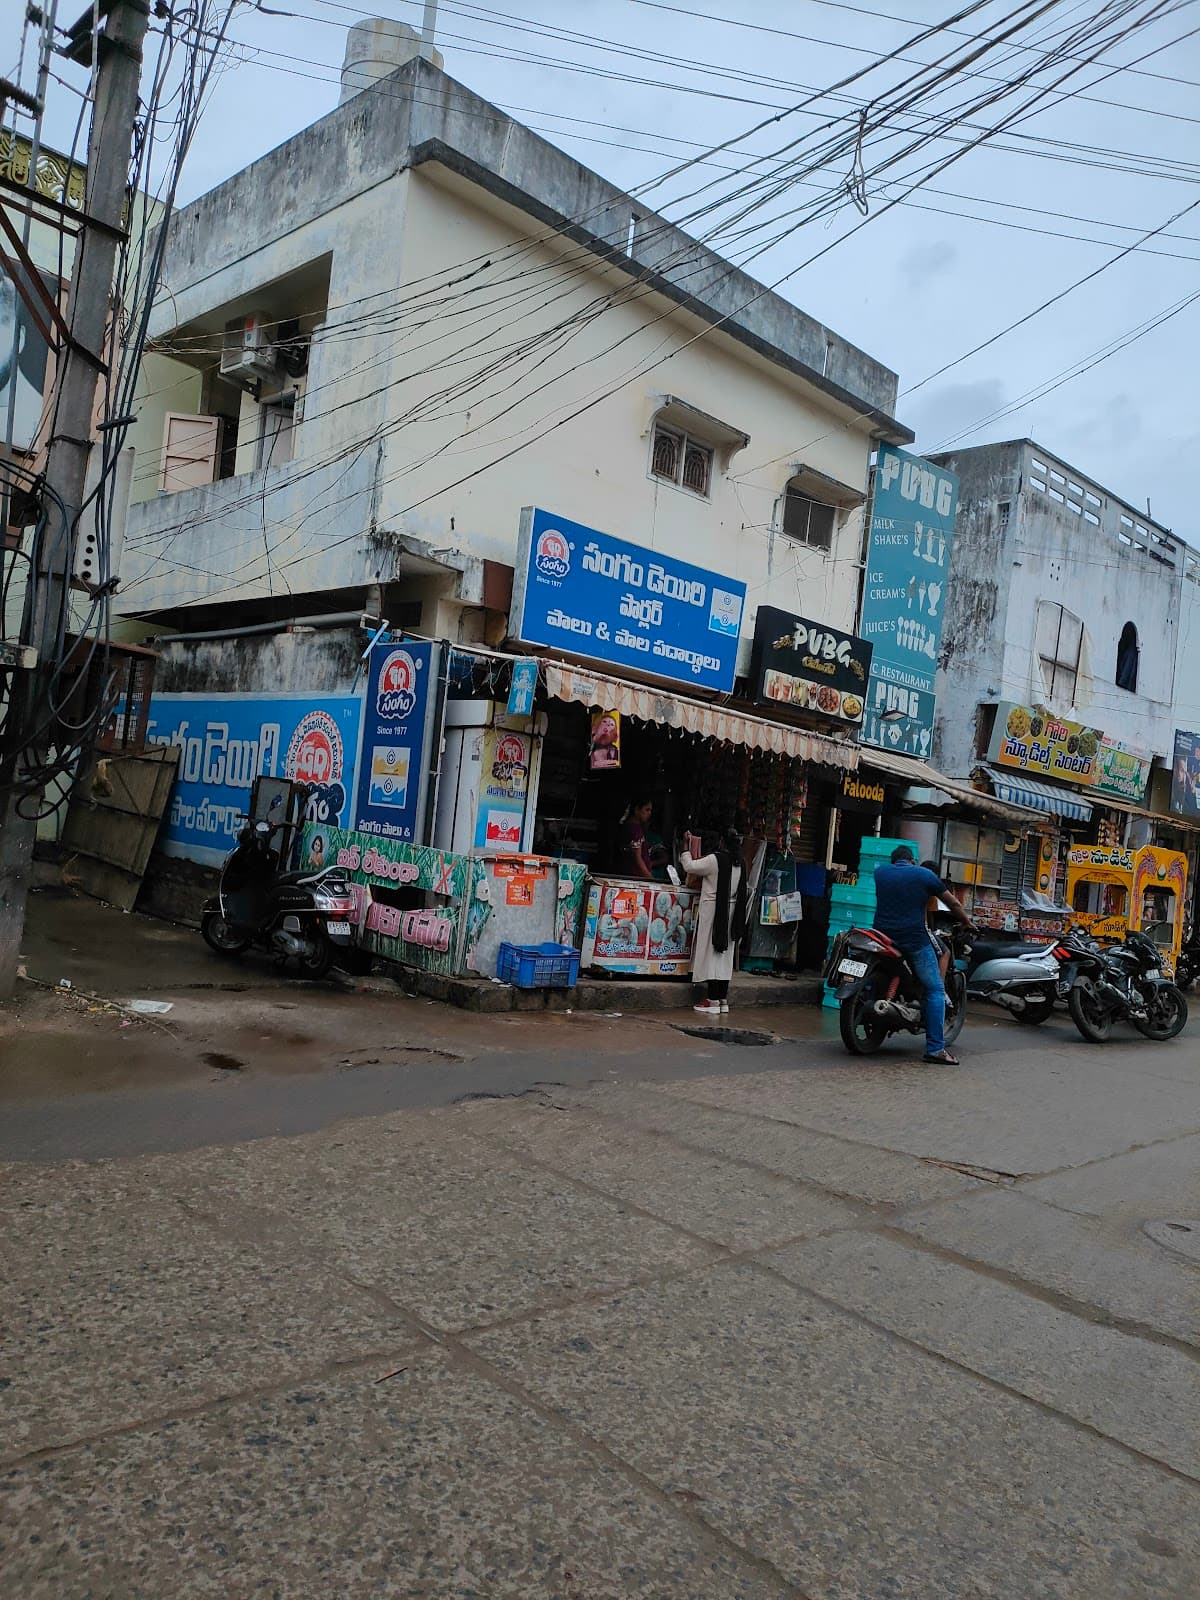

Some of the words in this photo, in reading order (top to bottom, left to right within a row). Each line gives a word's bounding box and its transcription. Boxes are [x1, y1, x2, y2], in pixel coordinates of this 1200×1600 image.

[874, 519, 895, 530] MILK
[874, 535, 909, 545] SHAKE'S
[582, 542, 644, 588] సంగం
[869, 573, 884, 583] ICE
[870, 588, 906, 600] CREAM'S
[619, 593, 663, 629] పార్లర్
[546, 608, 592, 636] పాలు
[595, 621, 610, 641] &
[615, 629, 650, 652] పాల
[865, 620, 896, 635] JUICE'S
[794, 621, 852, 668] PUBG
[881, 665, 931, 690] RESTAURANT
[382, 694, 410, 712] సంగం
[377, 725, 392, 735] Since
[394, 726, 407, 736] 1977
[1055, 750, 1092, 774] సెంటర్
[843, 776, 885, 803] Falooda
[359, 819, 381, 833] సంగం
[382, 822, 402, 837] పాలు
[403, 828, 411, 837] &
